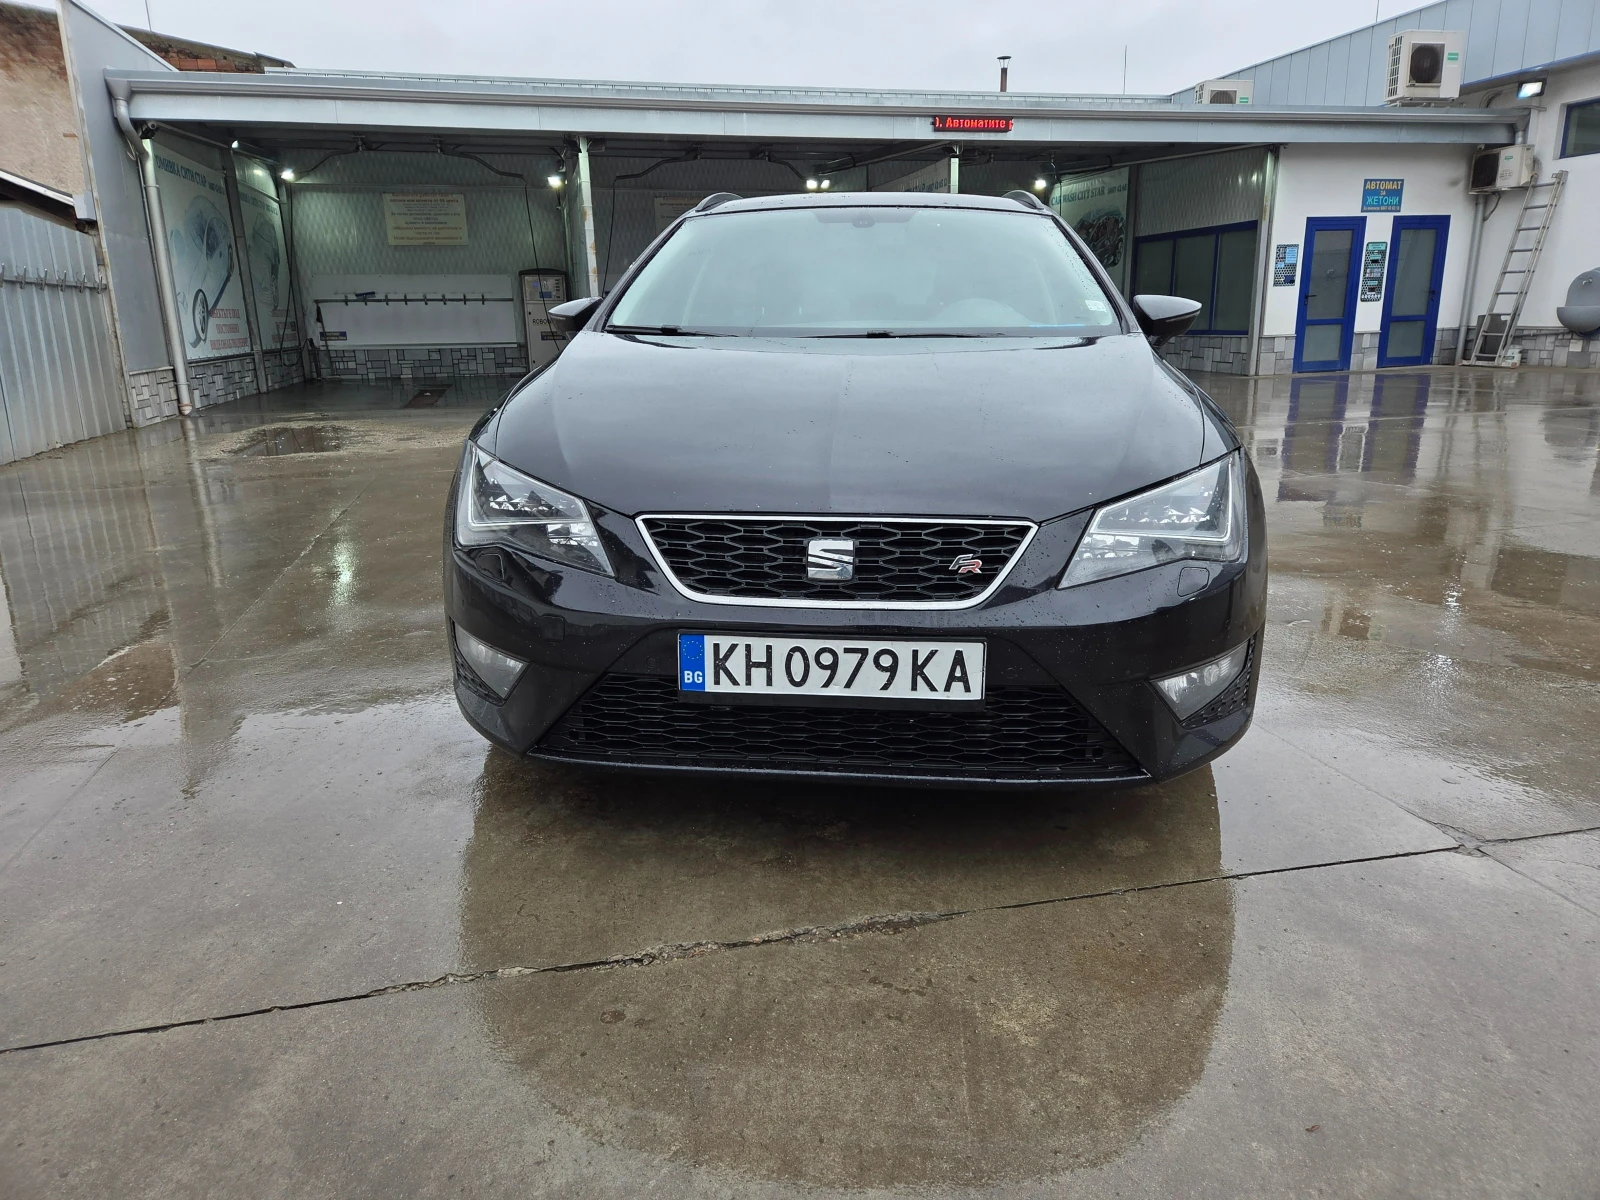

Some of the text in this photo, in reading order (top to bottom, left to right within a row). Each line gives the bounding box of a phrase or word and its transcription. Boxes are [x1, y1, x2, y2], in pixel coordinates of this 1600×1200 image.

[945, 117, 1006, 128] Автоматите
[1365, 180, 1402, 190] АВТОМАТ
[1062, 192, 1077, 203] WASH
[1077, 189, 1090, 200] CITY
[1091, 186, 1105, 198] STAR
[1366, 195, 1399, 205] ЖЕТОНИ
[948, 553, 983, 574] FR
[712, 642, 972, 693] KH 0979 KA
[684, 670, 703, 684] BG
